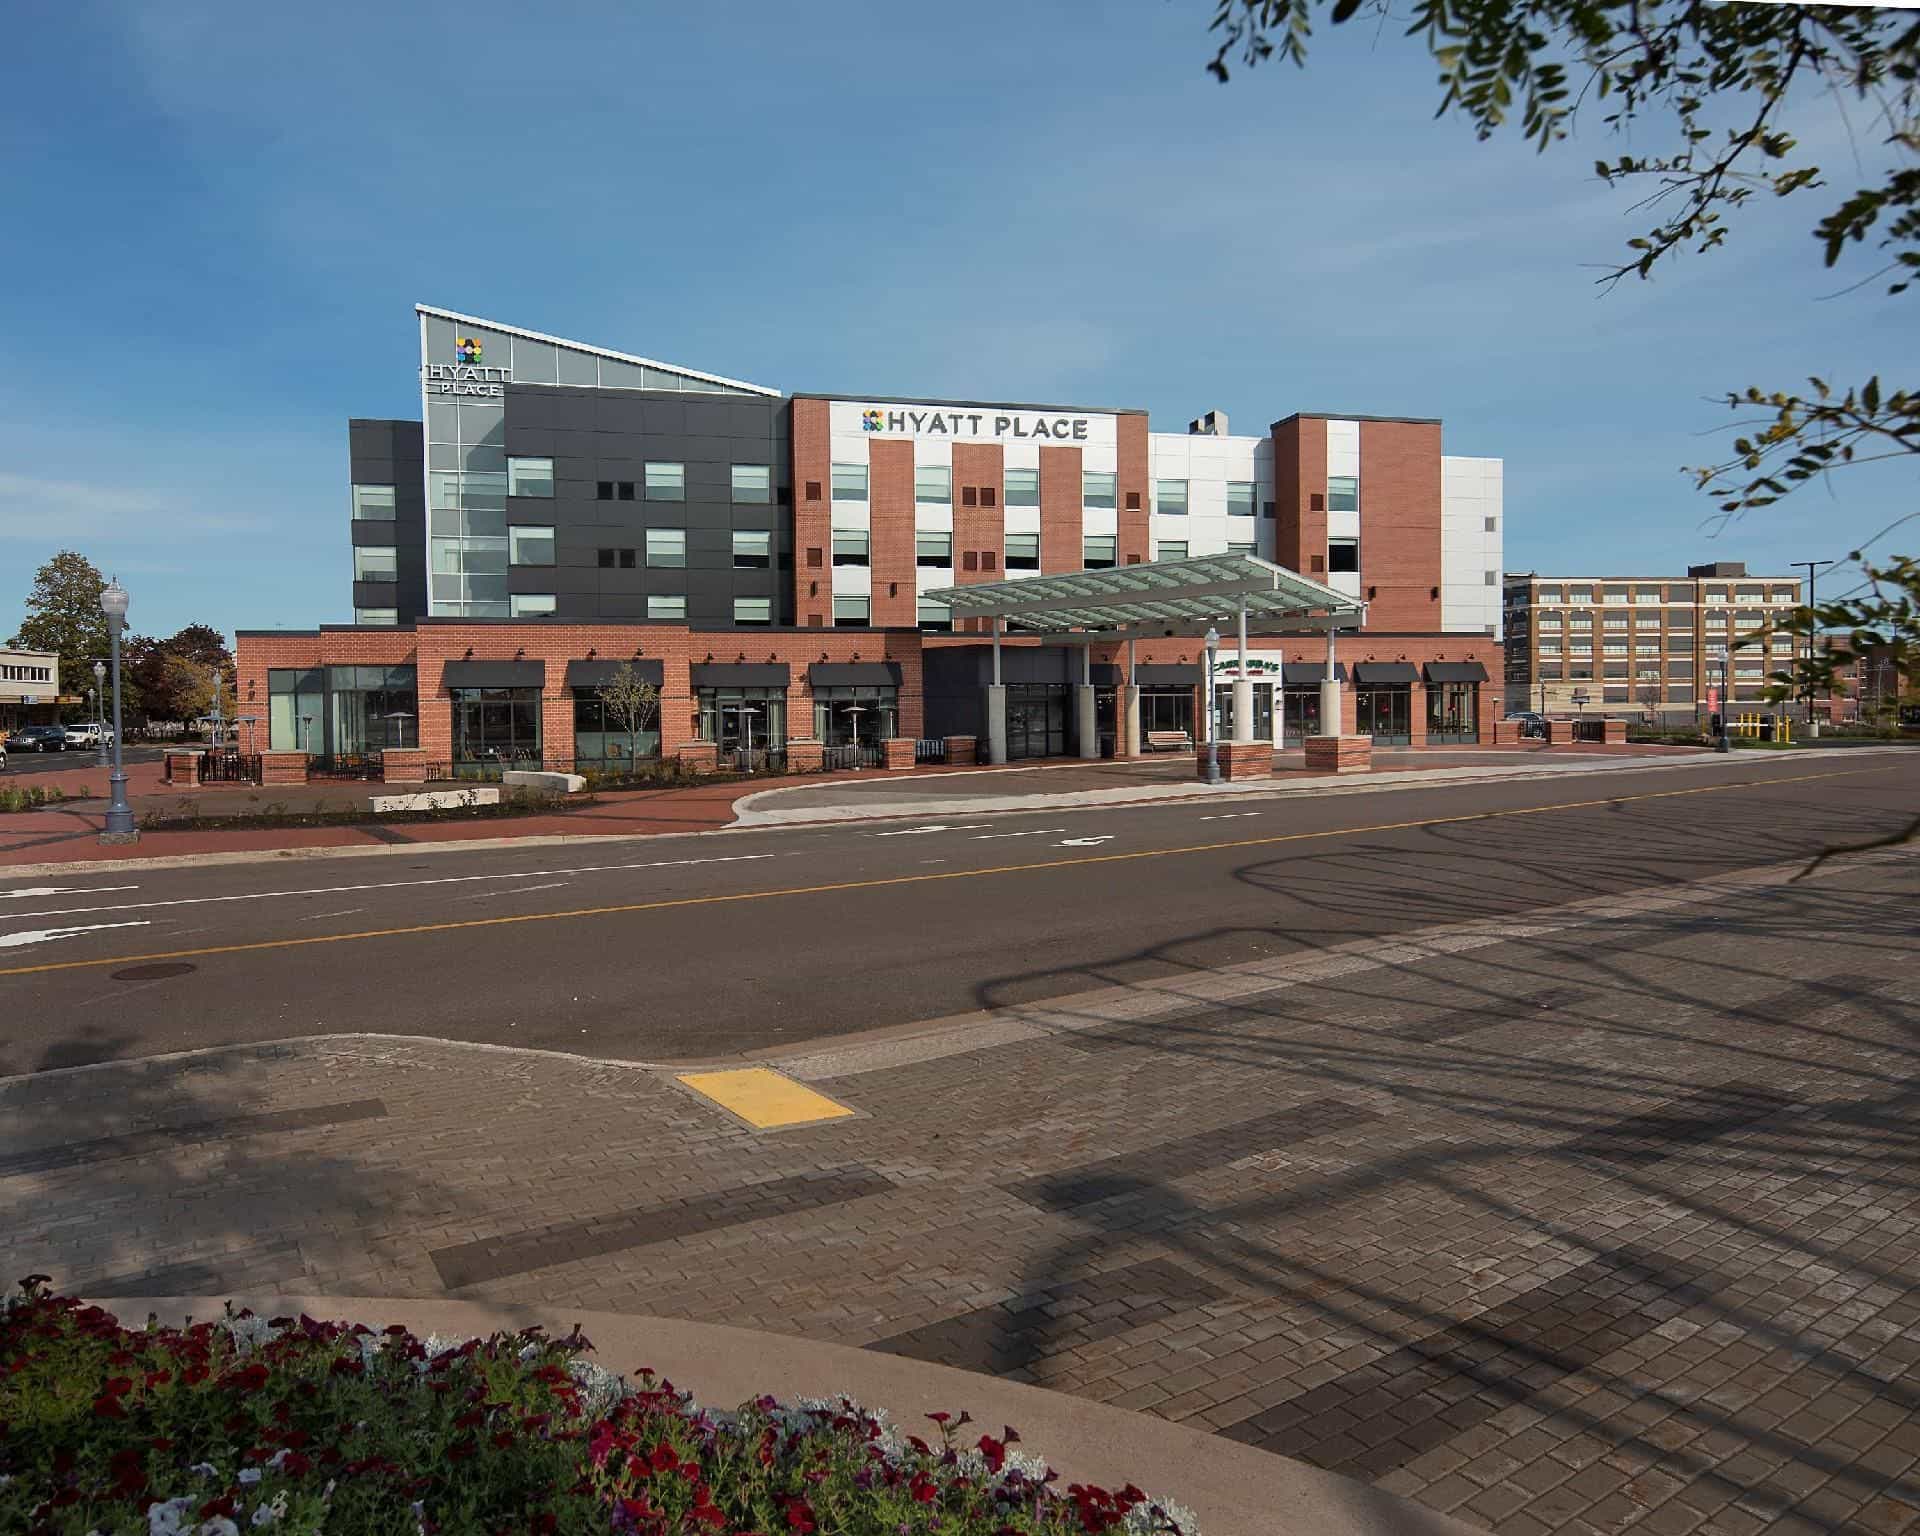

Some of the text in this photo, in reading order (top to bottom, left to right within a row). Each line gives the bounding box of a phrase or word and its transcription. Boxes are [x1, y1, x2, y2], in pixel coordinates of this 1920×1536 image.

[430, 364, 511, 382] HYATT
[441, 383, 499, 395] PLACE
[888, 411, 1088, 440] HYATT PLACE
